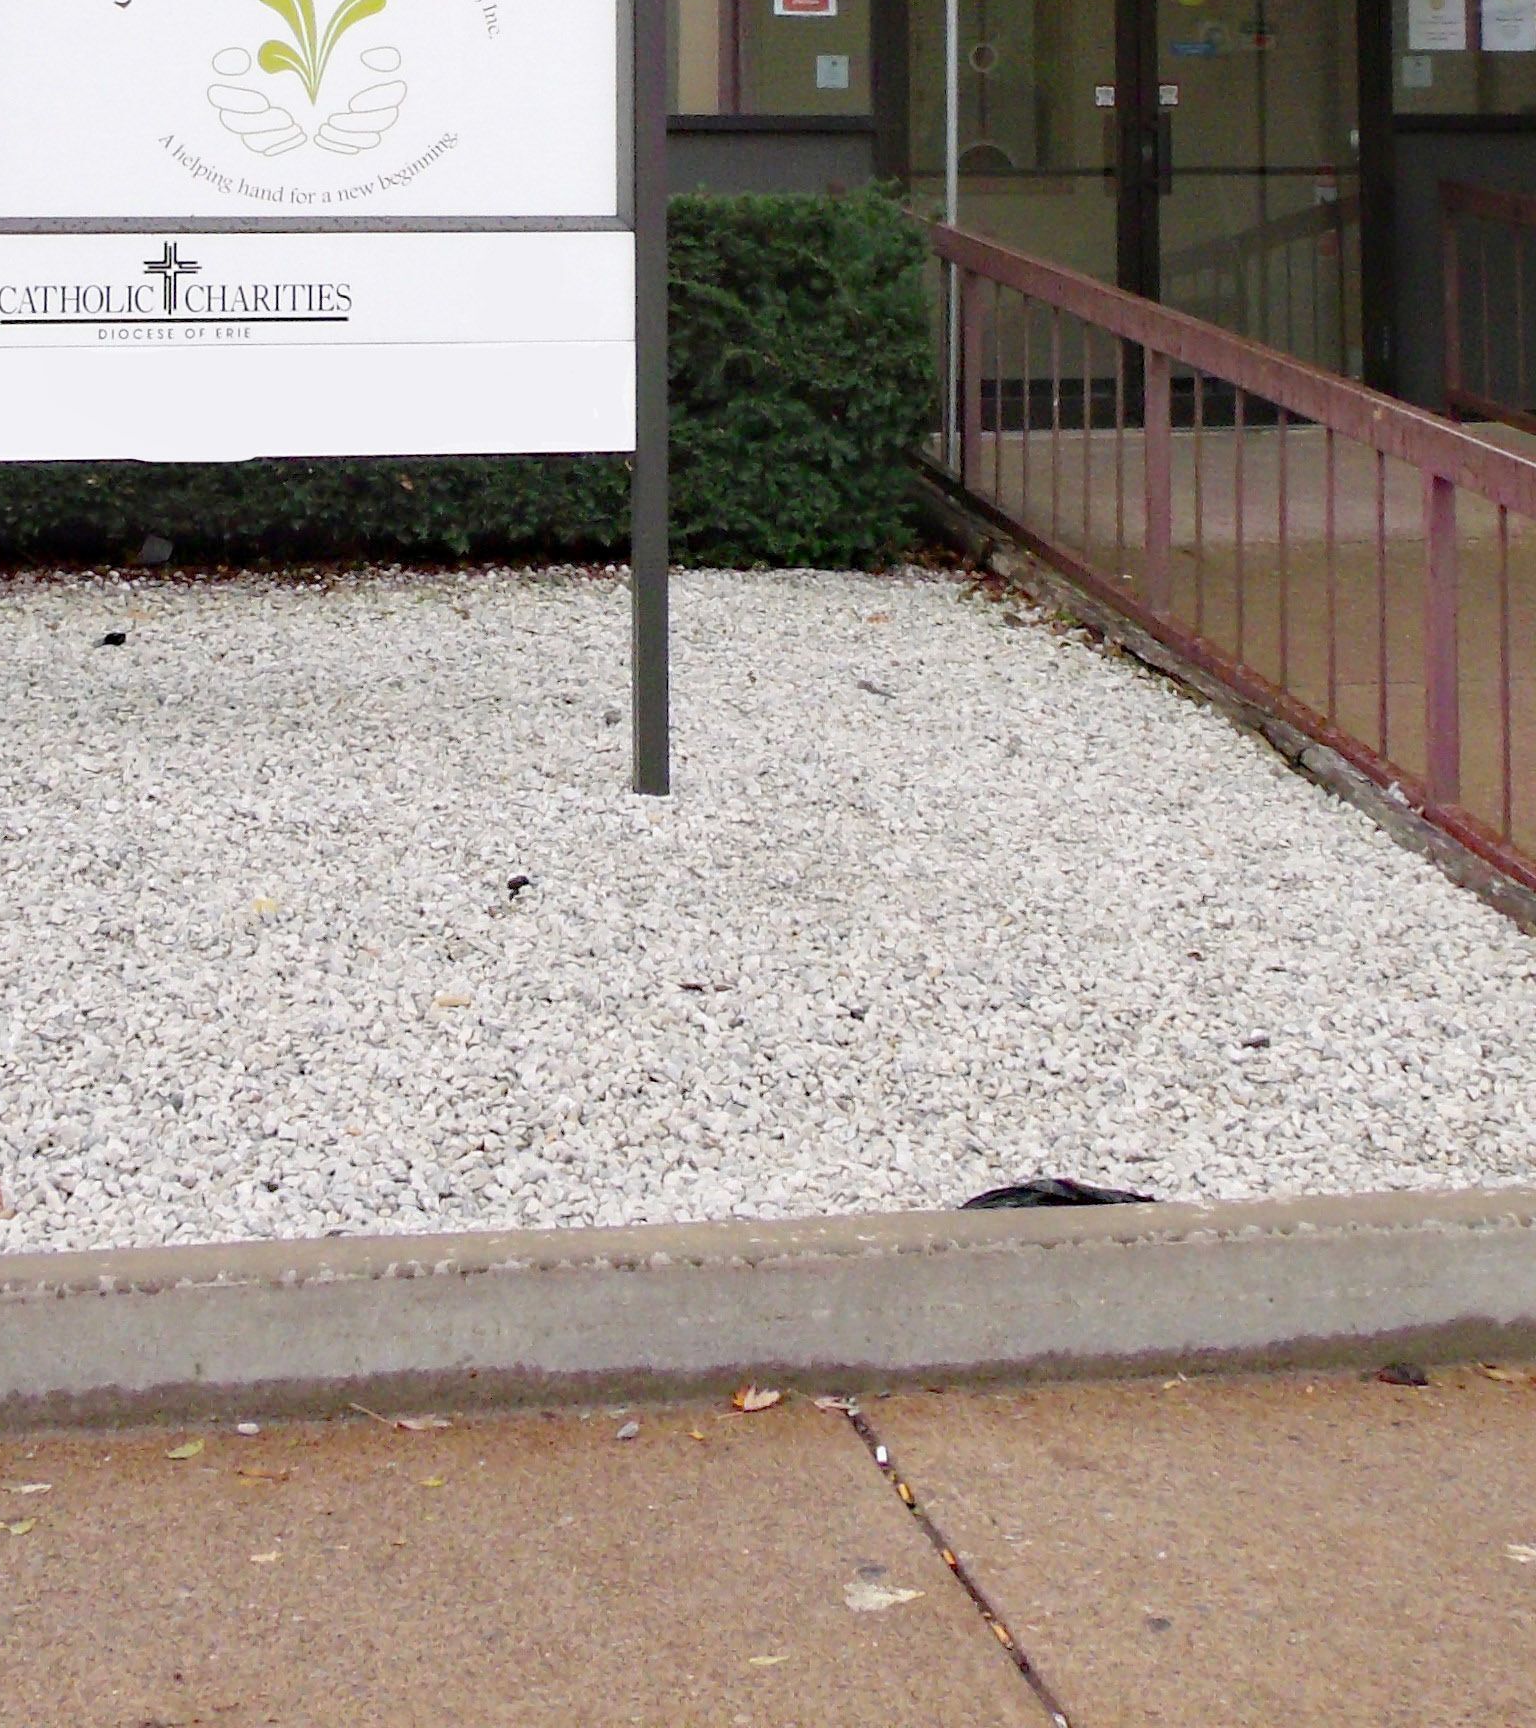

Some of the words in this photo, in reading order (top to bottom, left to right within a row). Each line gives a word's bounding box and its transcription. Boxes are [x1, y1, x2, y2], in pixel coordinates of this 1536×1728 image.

[481, 4, 502, 40] Inc.
[158, 133, 175, 149] A
[172, 143, 233, 194] helping
[238, 178, 284, 203] hand
[290, 187, 316, 205] for
[321, 192, 331, 204] a
[338, 181, 375, 203] new
[185, 283, 353, 313] CHARITIES
[98, 328, 173, 340] DIOCESE
[185, 328, 205, 340] OF
[216, 327, 251, 339] ERIE
